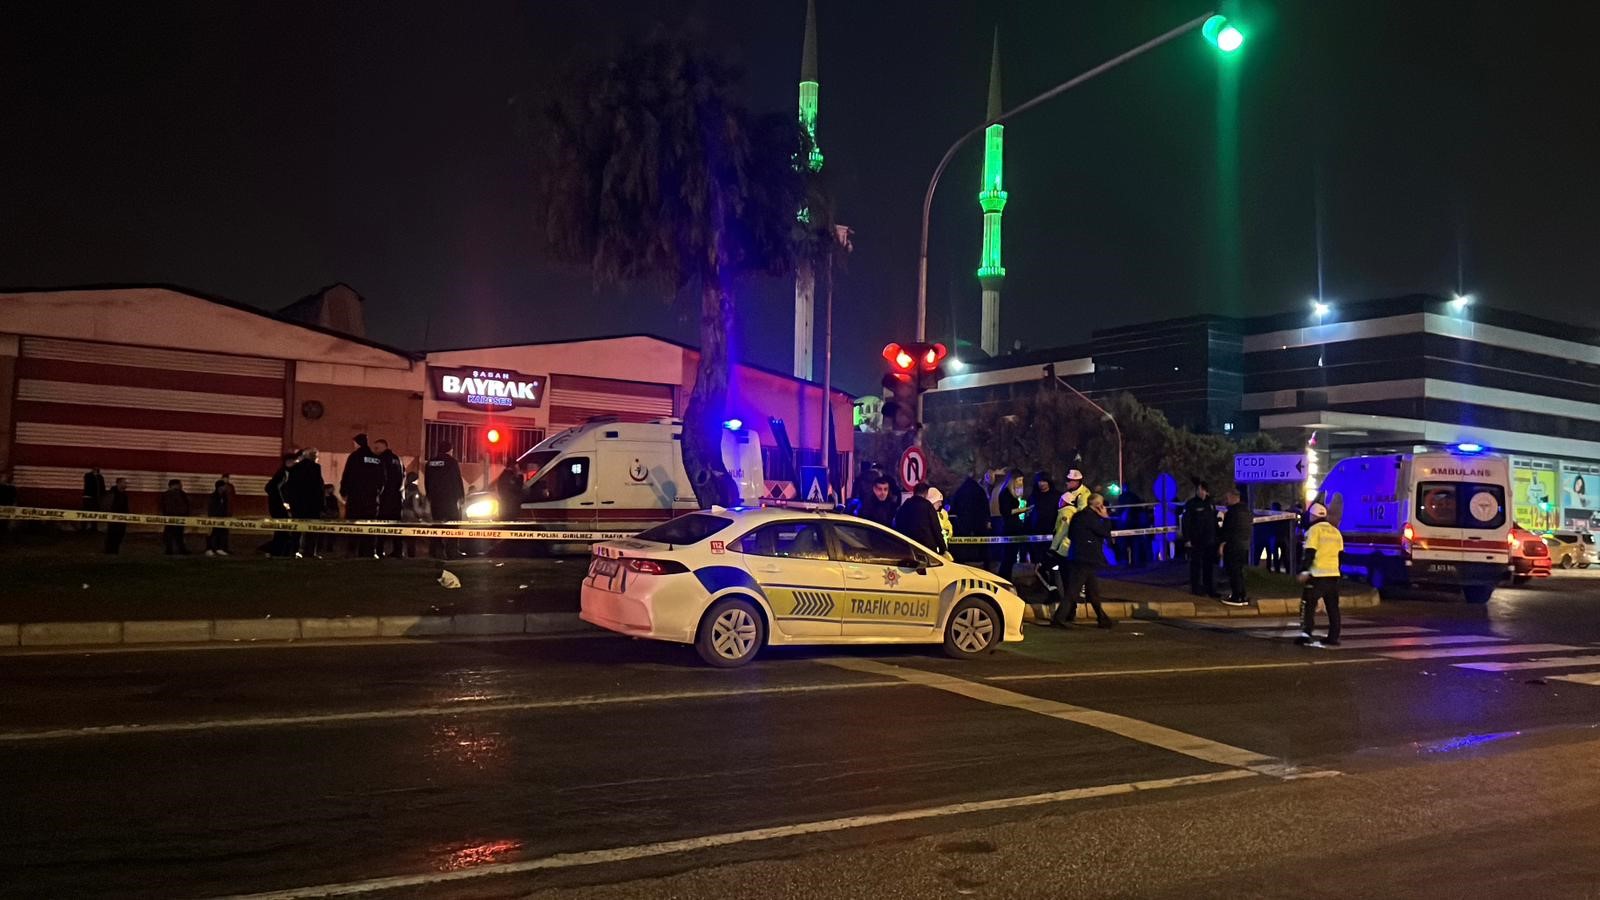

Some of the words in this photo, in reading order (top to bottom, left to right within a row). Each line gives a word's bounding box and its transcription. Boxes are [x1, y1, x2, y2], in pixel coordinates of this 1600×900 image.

[442, 375, 536, 400] BAYRAK
[467, 394, 513, 406] KAROSER
[1236, 457, 1265, 467] TCDD
[1271, 470, 1290, 478] Gar
[1430, 467, 1491, 477] AMBULANS
[712, 541, 723, 549] 112
[851, 597, 890, 616] TRAFİK
[893, 599, 930, 618] POLİSİ
